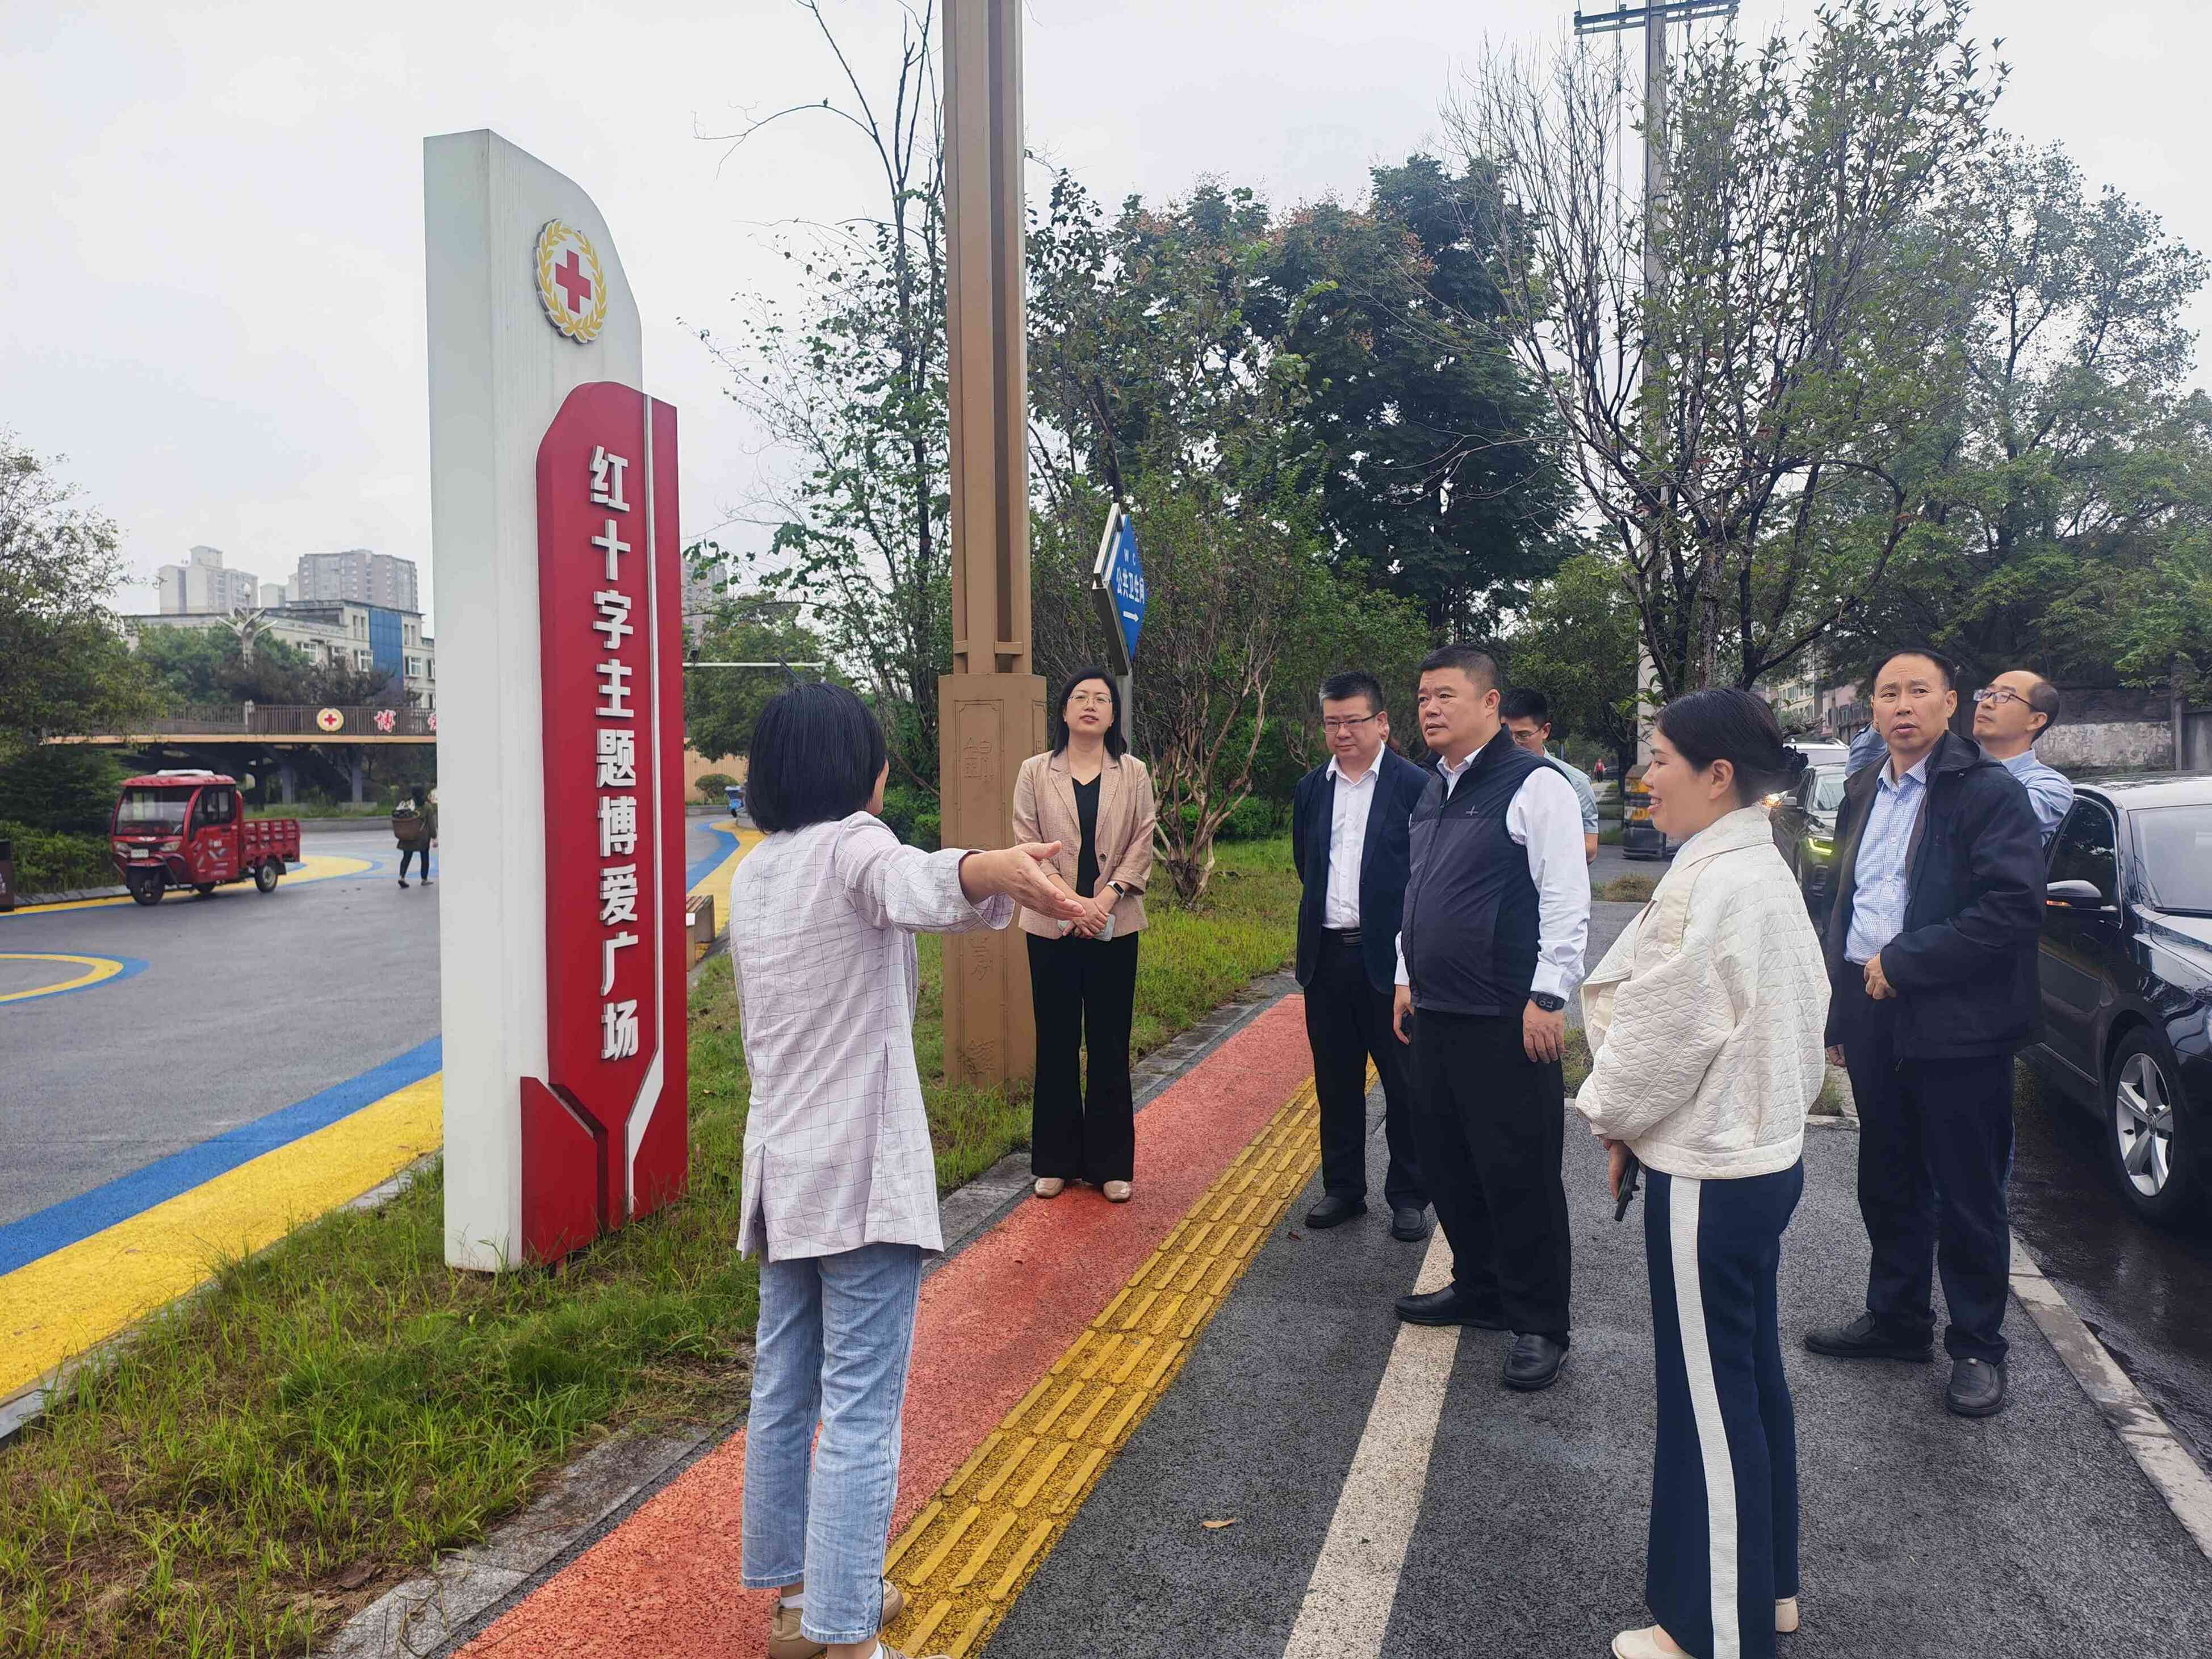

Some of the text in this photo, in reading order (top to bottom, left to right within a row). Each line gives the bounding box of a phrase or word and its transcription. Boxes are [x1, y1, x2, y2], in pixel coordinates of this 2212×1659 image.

[1116, 566, 1145, 605] 公共卫生间
[589, 445, 639, 1061] 红十字主题博爱广场
